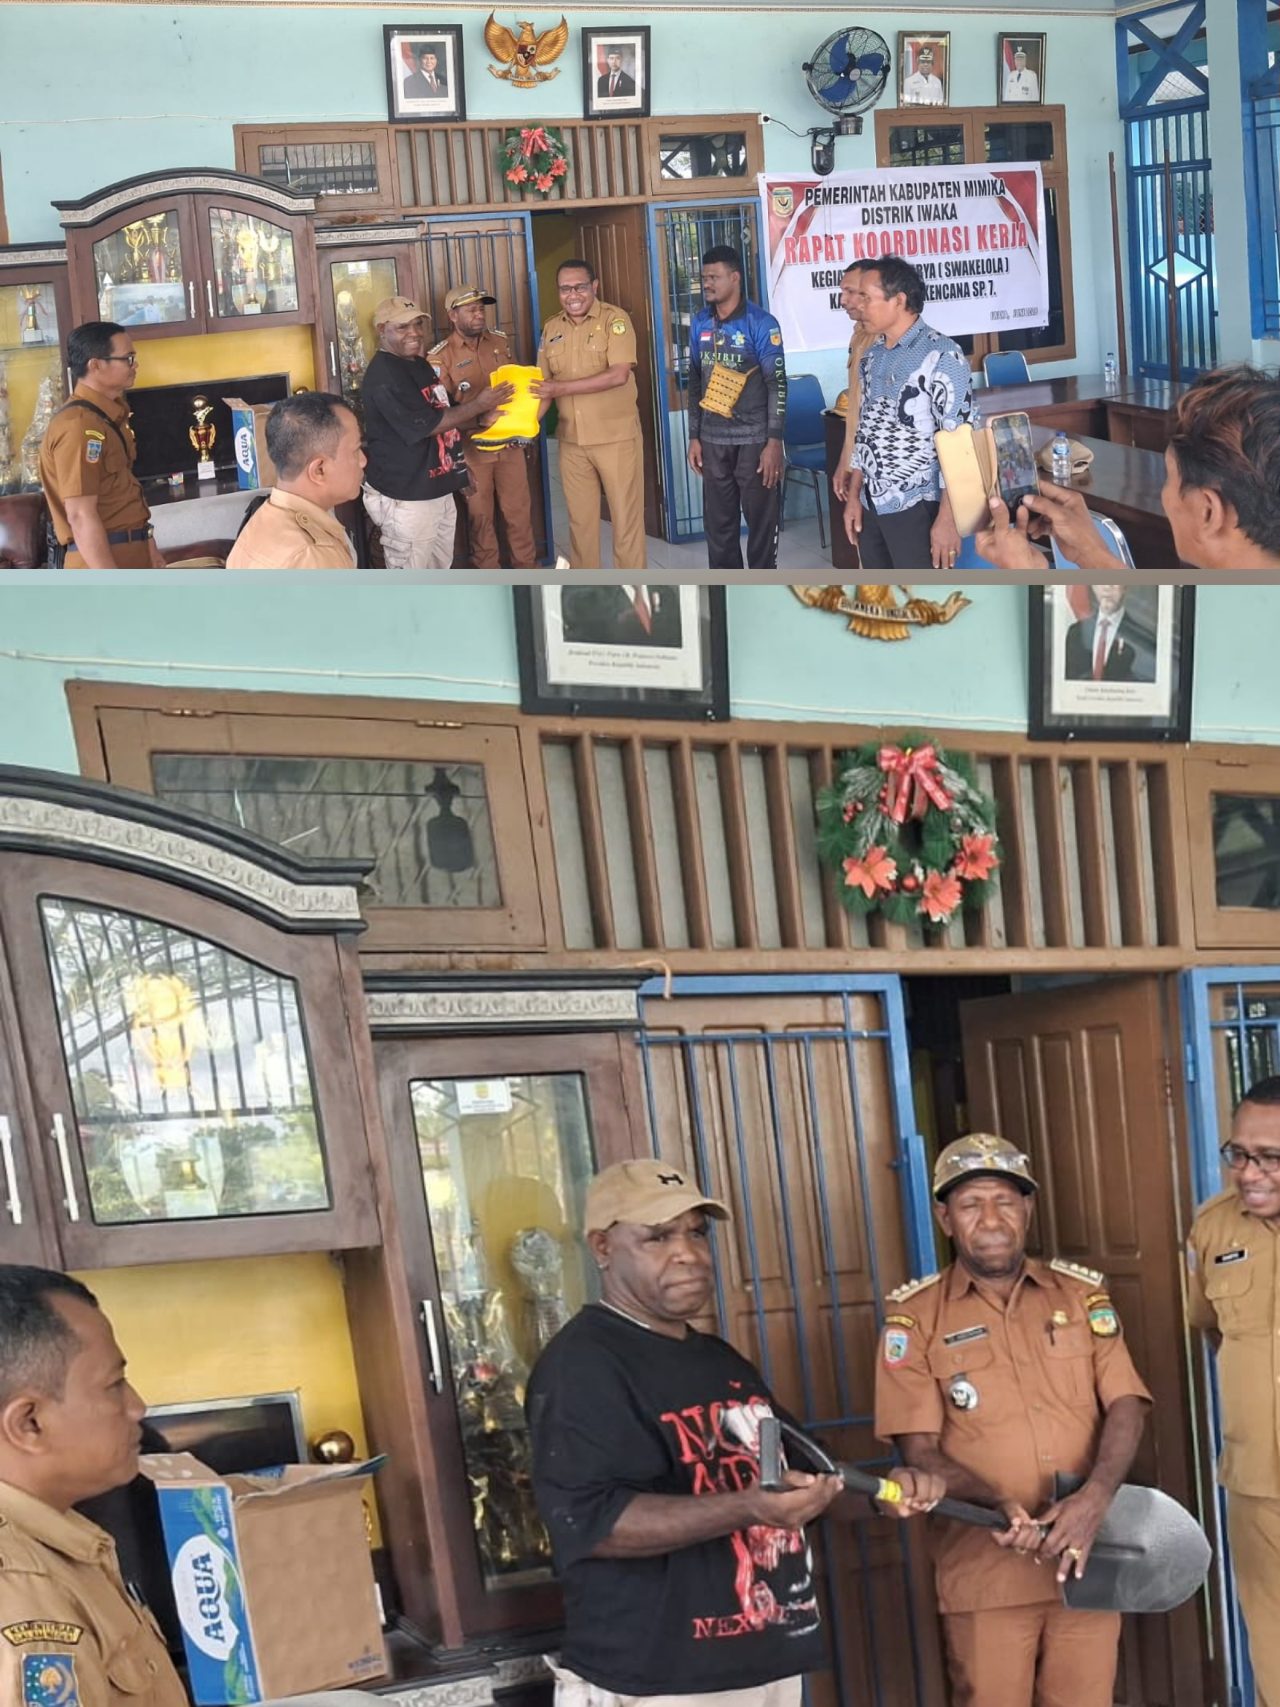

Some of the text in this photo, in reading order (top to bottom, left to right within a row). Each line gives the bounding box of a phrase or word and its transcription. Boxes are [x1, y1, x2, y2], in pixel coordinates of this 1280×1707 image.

[805, 178, 1006, 206] PEMERINTAH KABUPATEN MIMIKA
[862, 203, 958, 225] DISTRIK IWAKA
[784, 223, 1028, 264] RAPAT KOORDINASI KERJA
[945, 258, 1003, 277] SWAKELOLA
[924, 281, 970, 301] KENCANA
[973, 280, 987, 297] SP.
[241, 433, 250, 466] AQUA
[192, 1552, 226, 1643] AQUA
